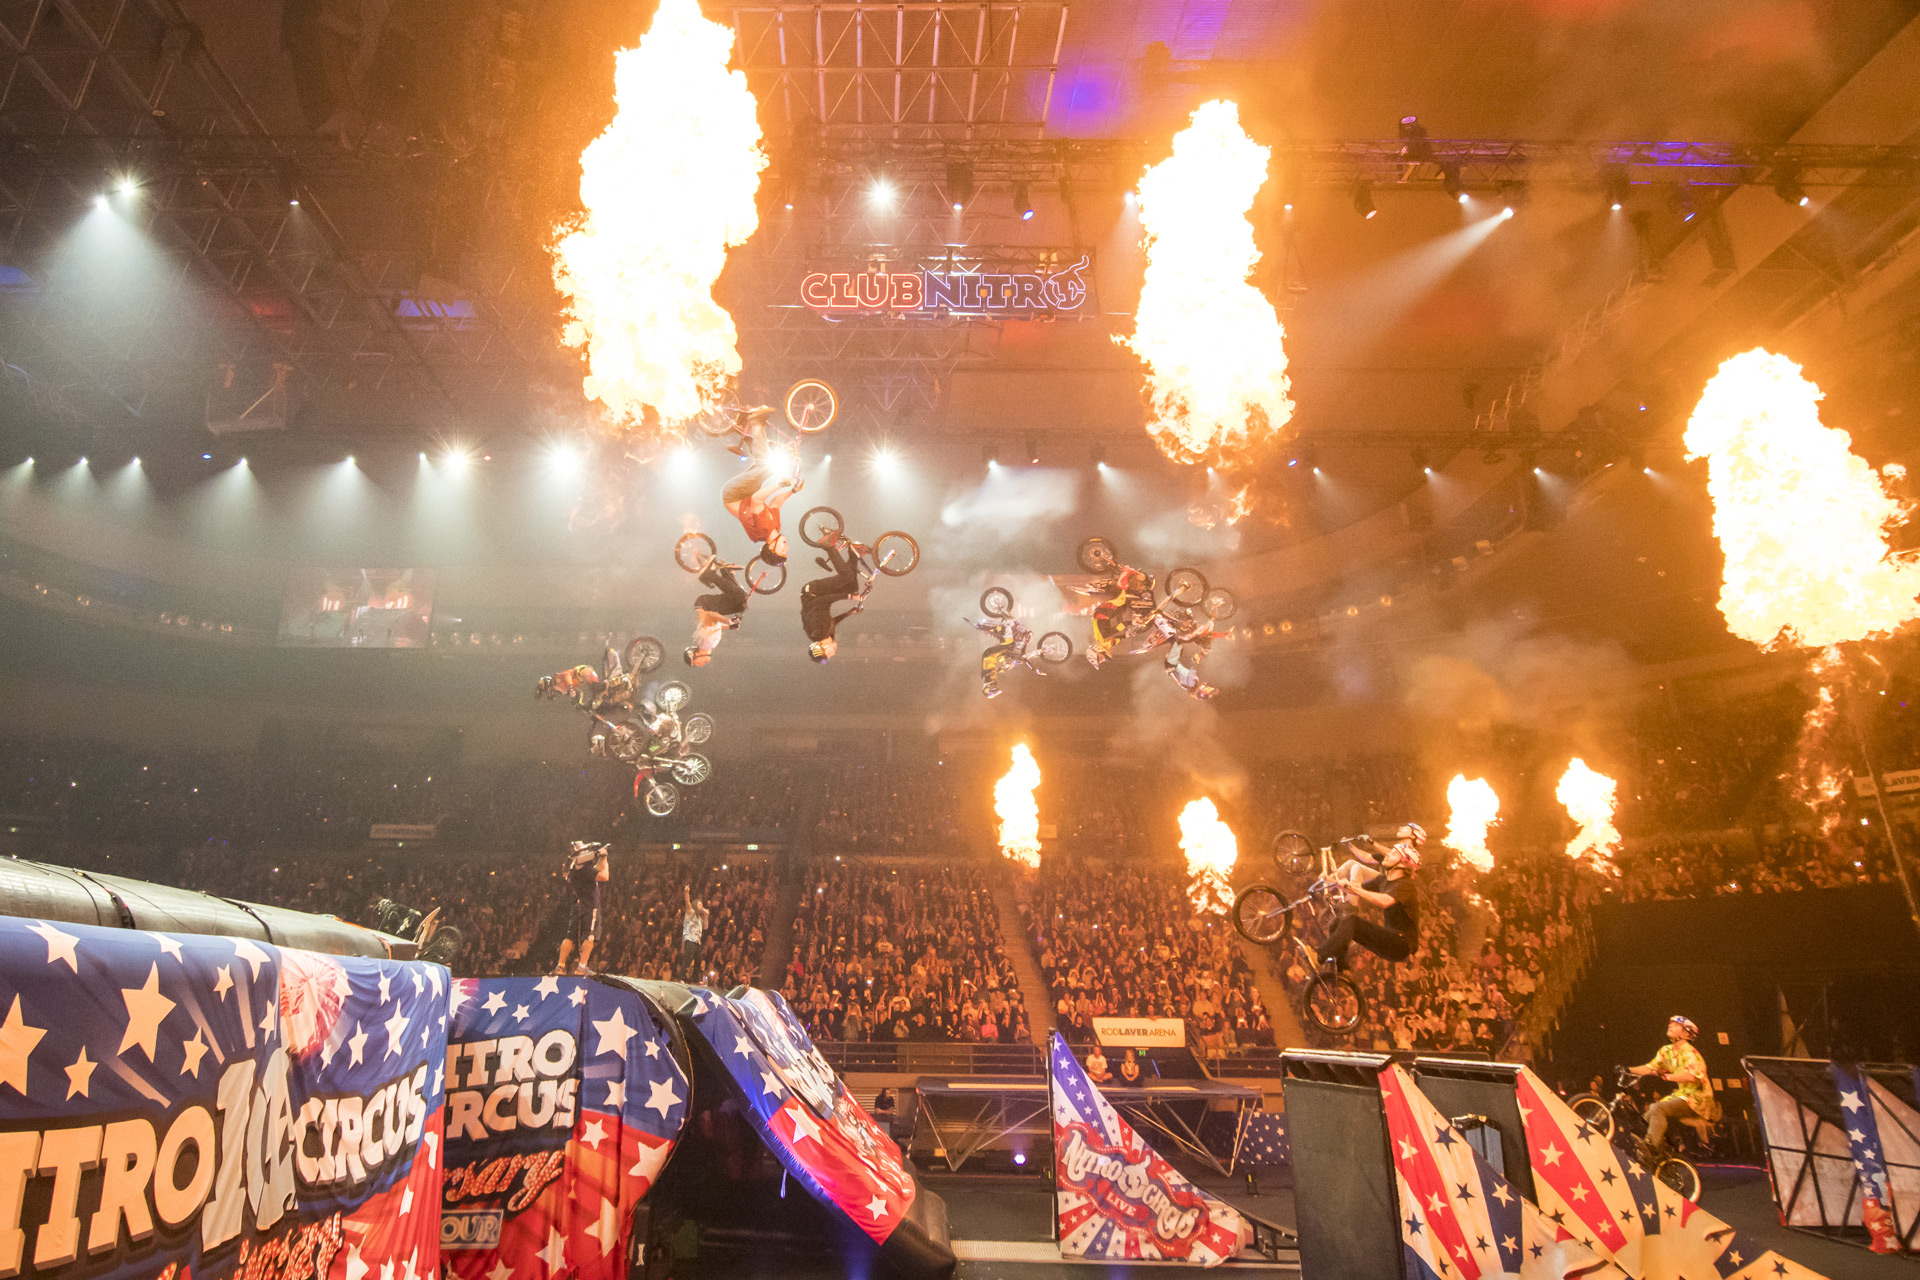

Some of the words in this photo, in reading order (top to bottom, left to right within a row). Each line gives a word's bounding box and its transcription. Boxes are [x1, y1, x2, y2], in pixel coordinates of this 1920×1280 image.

[1149, 1028, 1177, 1037] ARENA
[293, 1065, 428, 1186] CIRCUS
[443, 1078, 580, 1142] RCUS
[1105, 1189, 1137, 1217] LIVE
